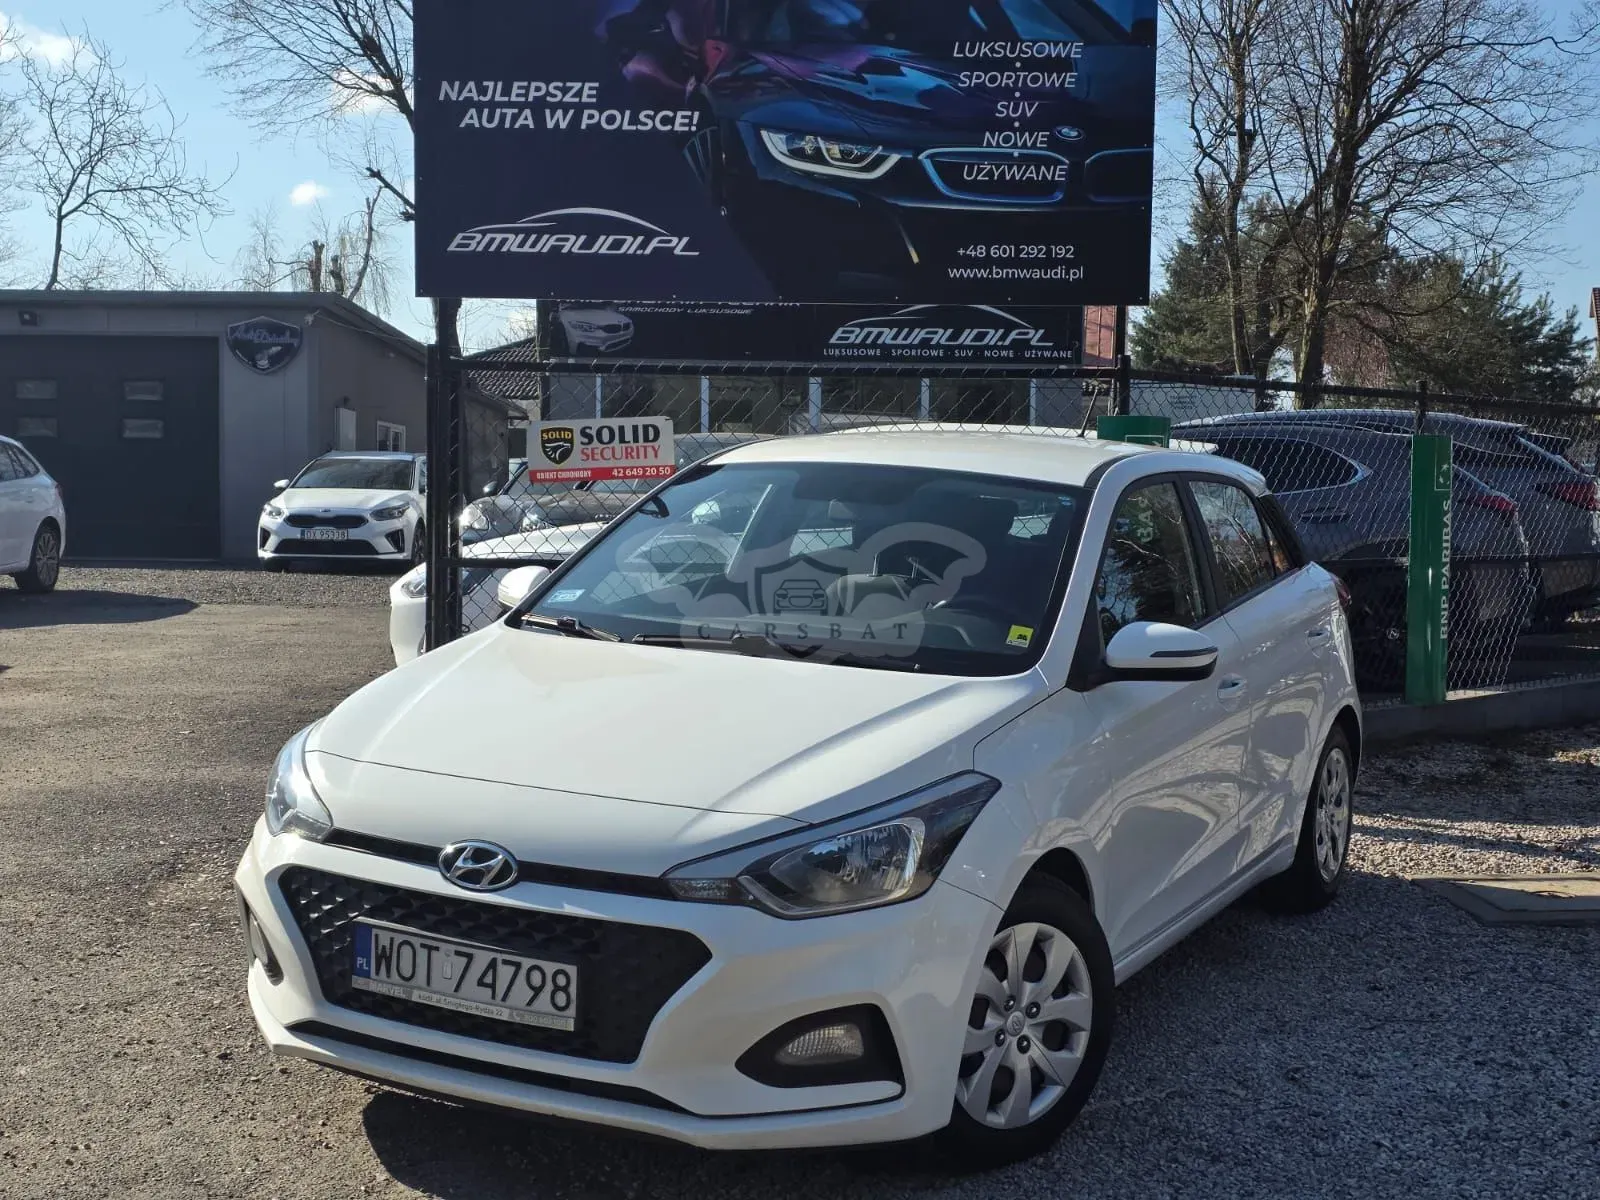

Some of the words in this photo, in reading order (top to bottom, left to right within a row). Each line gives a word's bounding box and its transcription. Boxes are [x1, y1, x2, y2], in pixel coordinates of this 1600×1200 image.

[952, 41, 1084, 59] LUKSUSOWE
[958, 71, 1078, 88] SPORTOWE
[438, 80, 600, 103] NAJLEPSZE
[995, 101, 1039, 118] SUV
[459, 108, 535, 129] AUTA
[545, 108, 574, 130] W
[581, 109, 700, 132] POLSCE!
[982, 131, 1050, 148] NOWE
[962, 161, 1068, 182] UŻYWANE
[446, 231, 700, 257] BMWAUDI.PL
[957, 245, 987, 258] +48
[990, 245, 1016, 258] 601
[1019, 245, 1047, 258] 292
[1050, 245, 1075, 258] 192
[948, 265, 1084, 281] www.bmwaudi.pl
[828, 327, 1054, 346] BMWAUDI.PL
[823, 347, 881, 356] LUKSUSOWE
[891, 348, 944, 357] SPORTOWE
[954, 349, 974, 358] SUV
[984, 350, 1015, 358] NOWE
[1024, 349, 1073, 359] UŻYWANE
[542, 430, 572, 440] SOLID
[579, 423, 661, 446] SOLID
[580, 444, 661, 462] SECURITY
[612, 468, 624, 478] 42
[625, 467, 643, 477] 649
[645, 467, 657, 476] 20
[659, 466, 671, 476] 50
[1441, 498, 1452, 592] PARIBAS
[1440, 595, 1450, 640] BNP
[356, 956, 369, 971] PL
[374, 933, 440, 987] WOT
[453, 951, 572, 1012] 74798
